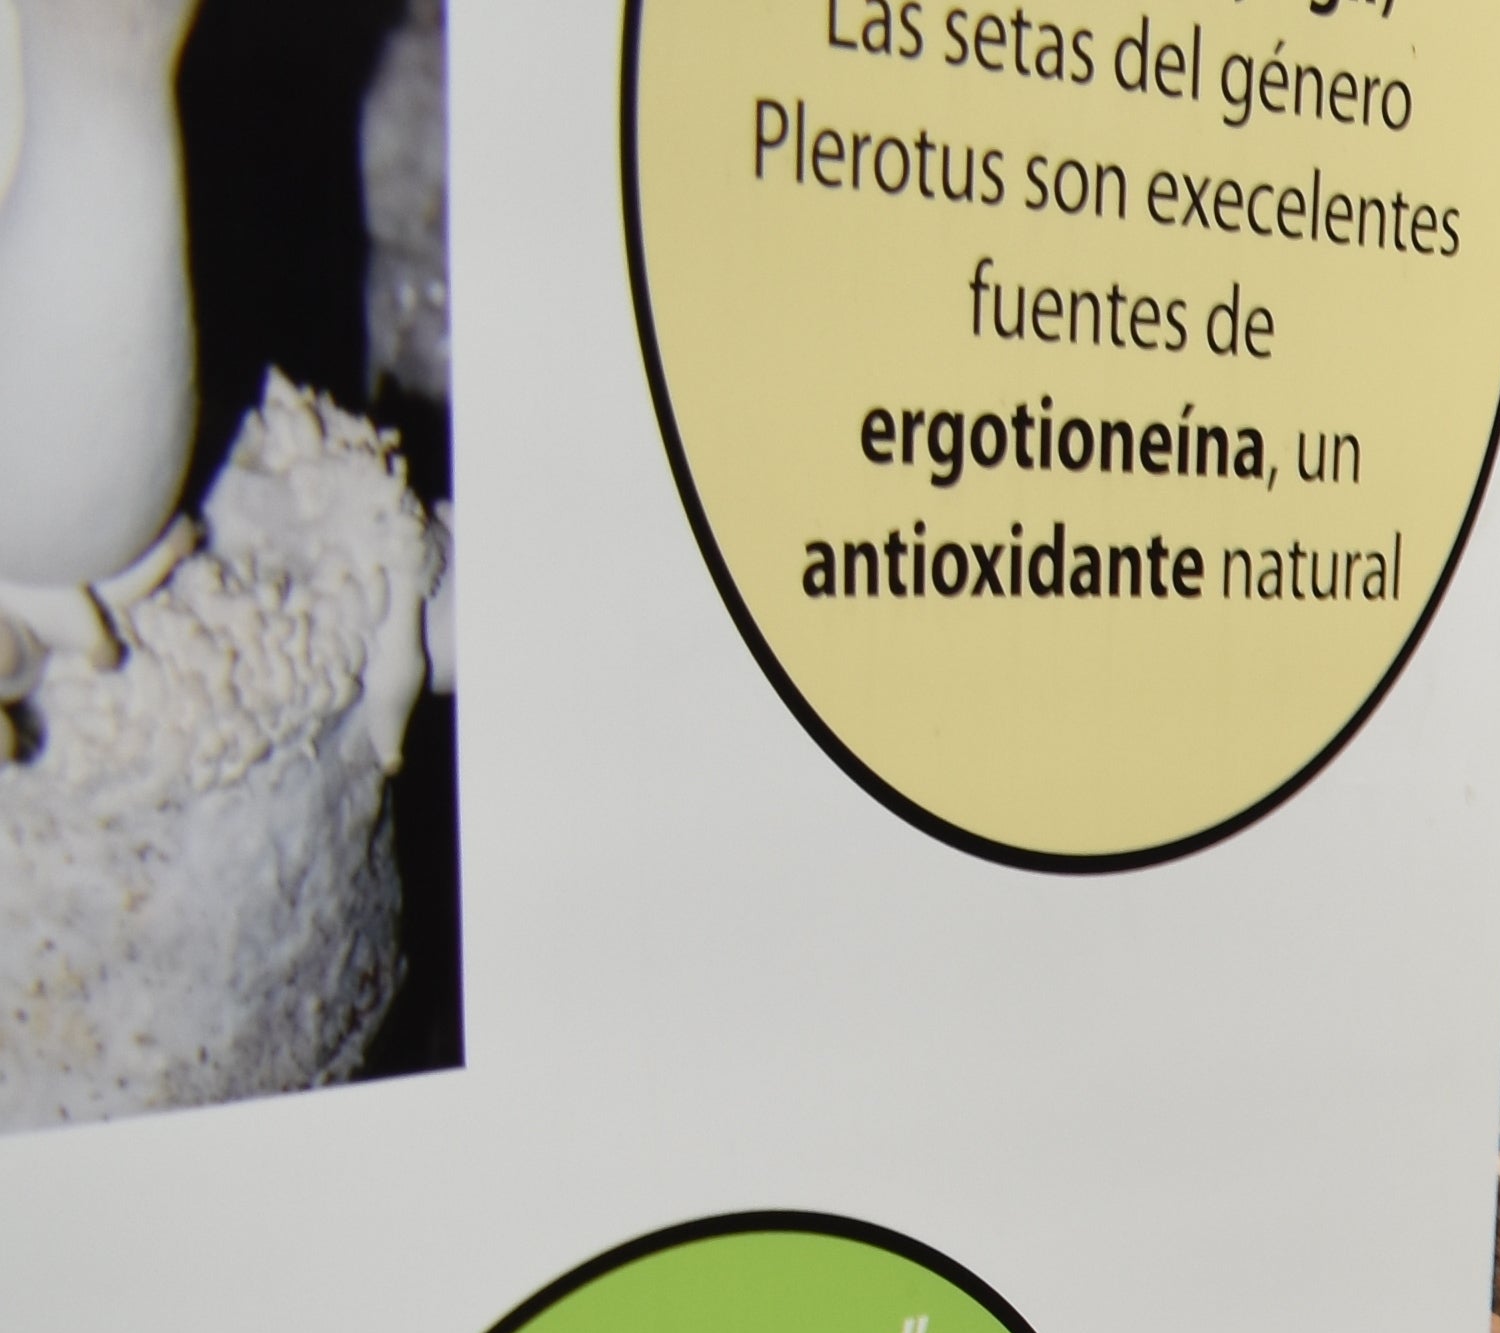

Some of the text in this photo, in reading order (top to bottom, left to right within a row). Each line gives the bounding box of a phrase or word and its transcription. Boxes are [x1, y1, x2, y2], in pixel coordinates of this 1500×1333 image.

[826, 0, 1413, 131] Las setas del género
[754, 99, 1461, 258] Plerotus son execelentes
[969, 257, 1274, 359] fuentes de
[860, 395, 1361, 491] ergotioneína, un
[802, 521, 1402, 601] antioxidante natural
